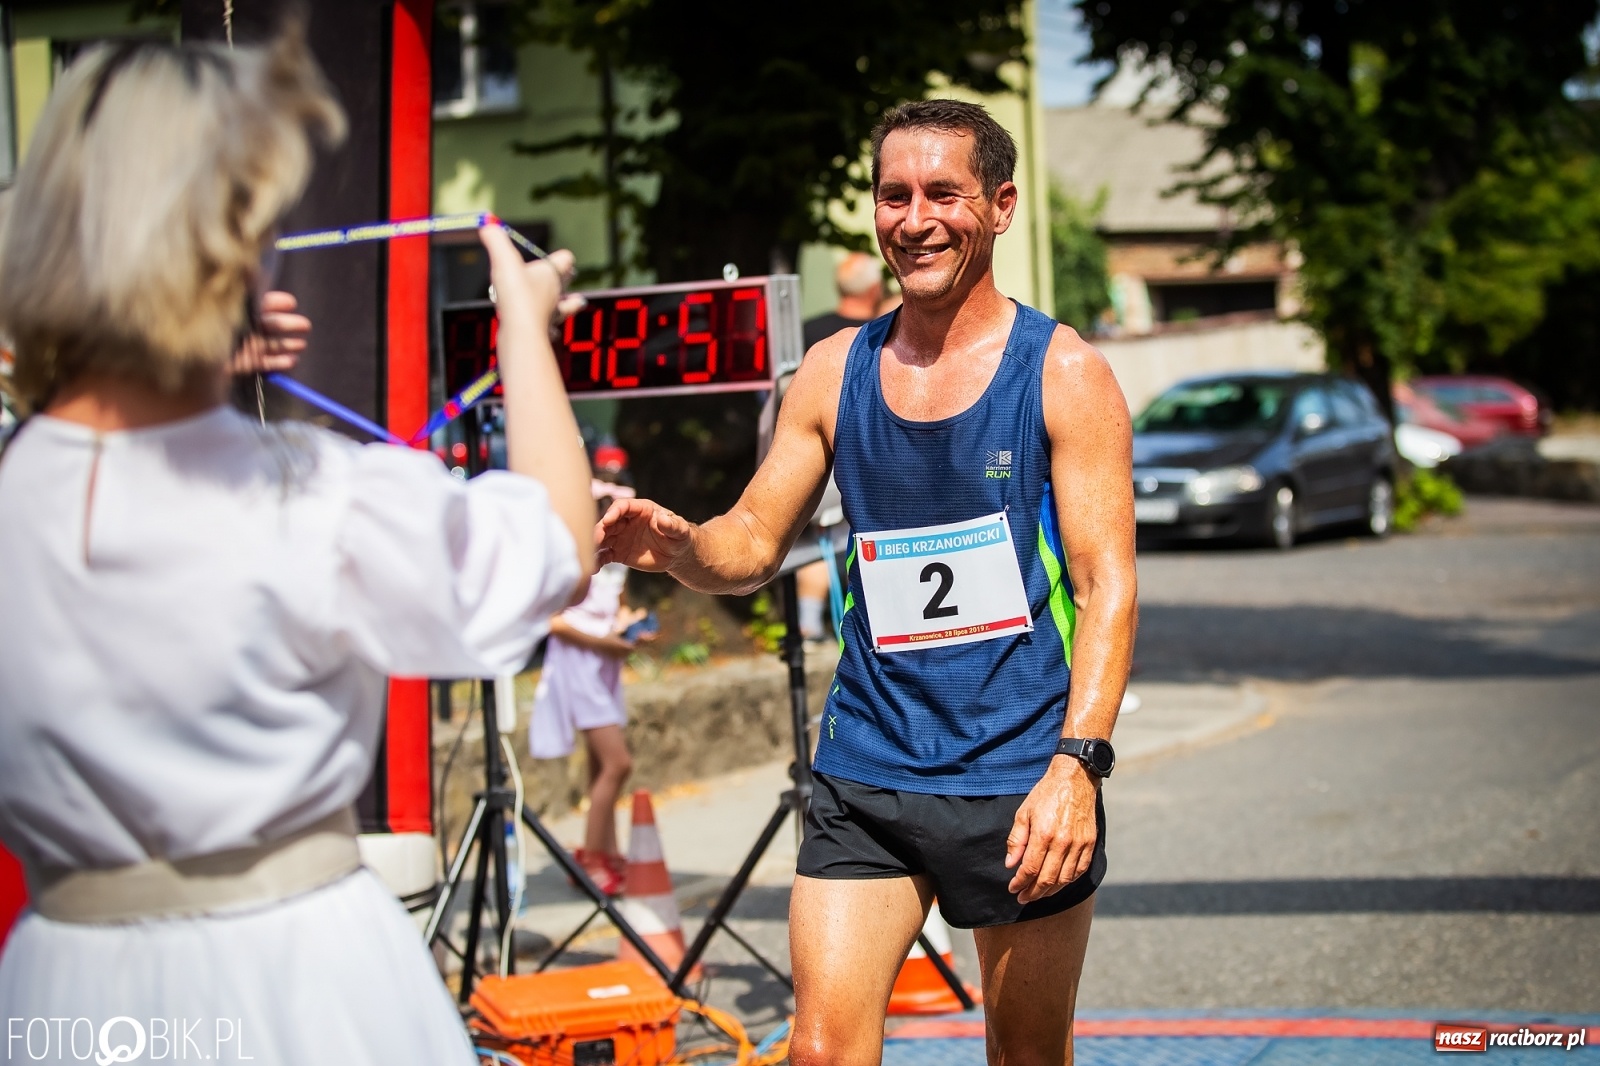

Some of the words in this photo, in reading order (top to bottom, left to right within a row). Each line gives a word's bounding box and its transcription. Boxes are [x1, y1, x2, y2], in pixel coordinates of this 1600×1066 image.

[986, 470, 1011, 478] RUN
[885, 543, 910, 555] BIEG
[912, 528, 1000, 553] KRZANOWICKI
[919, 562, 959, 620] 2
[909, 633, 944, 642] Krzanowice,
[953, 629, 968, 637] lipca
[969, 625, 985, 634] 2019
